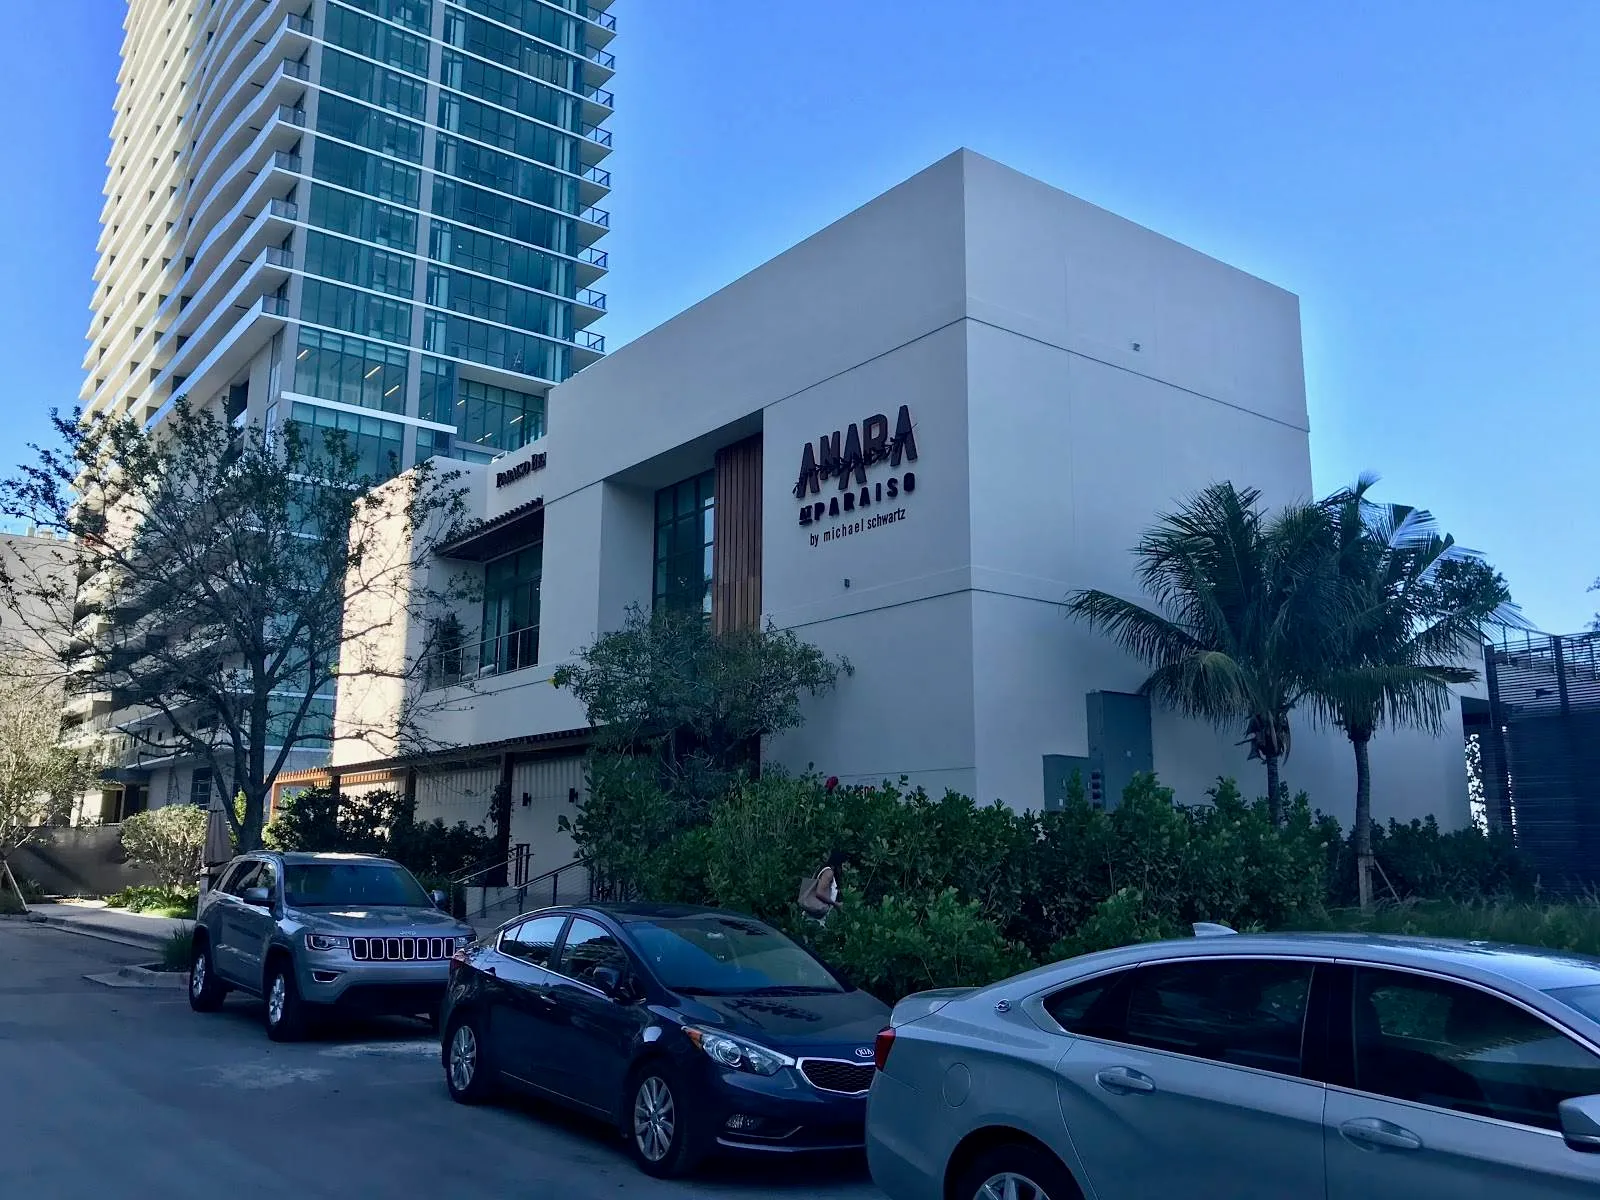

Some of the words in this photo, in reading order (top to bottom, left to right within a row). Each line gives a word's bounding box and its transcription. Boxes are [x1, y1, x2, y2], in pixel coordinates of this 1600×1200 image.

[794, 404, 918, 499] AMARA
[814, 472, 916, 521] PARAISO
[809, 533, 819, 547] by
[823, 518, 864, 542] michael
[867, 508, 906, 530] schwartz
